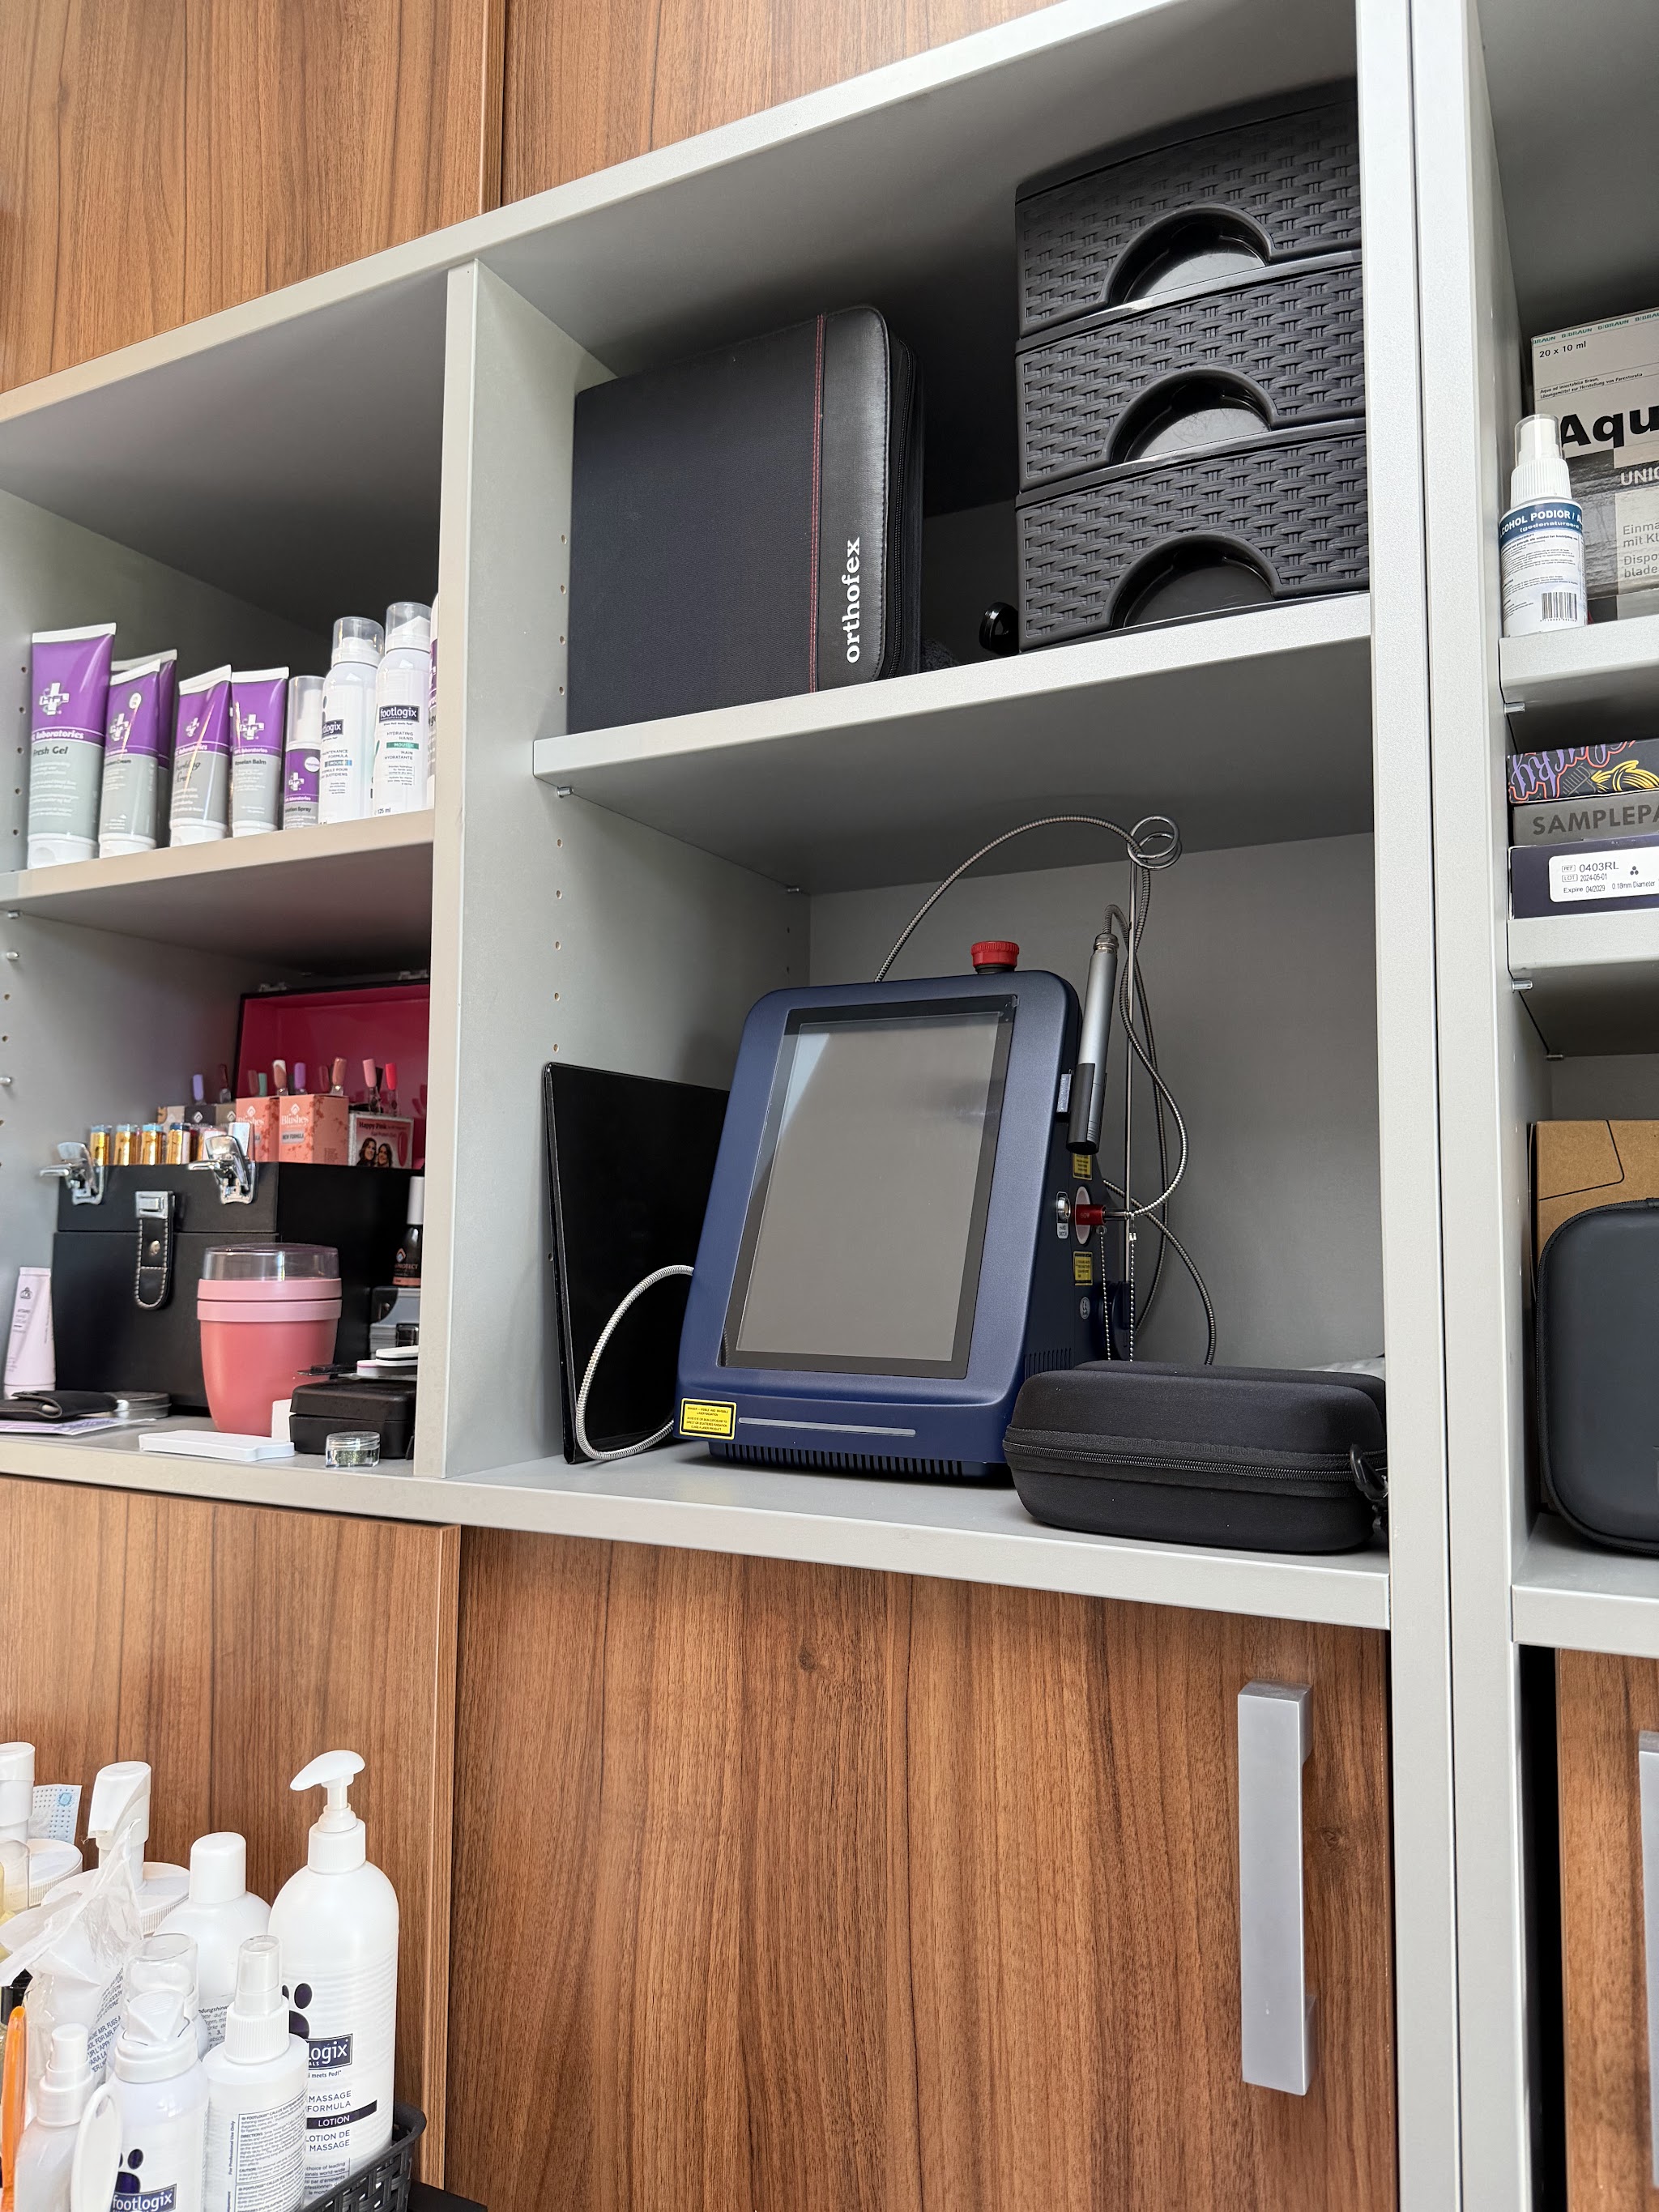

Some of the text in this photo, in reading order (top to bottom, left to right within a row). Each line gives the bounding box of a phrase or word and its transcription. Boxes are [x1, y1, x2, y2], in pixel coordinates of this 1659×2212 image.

[1539, 349, 1550, 358] 20
[1563, 344, 1573, 352] 10
[1576, 340, 1586, 349] ml
[1500, 515, 1528, 538] COHOL
[1530, 509, 1571, 521] PODIOR
[1623, 536, 1643, 548] mit
[841, 536, 860, 663] orthofex
[380, 708, 417, 718] footlogix
[36, 730, 84, 739] laboratories
[52, 745, 69, 754] Gel
[1579, 861, 1619, 872] 0403RL
[1580, 874, 1608, 882] 2024-05-01
[281, 1115, 309, 1124] Blushes
[309, 2040, 348, 2064] ogix
[309, 2090, 352, 2103] MASSAGE
[307, 2100, 351, 2112] FORMULA
[318, 2115, 350, 2127] LOTION
[339, 2129, 350, 2138] DE
[309, 2139, 350, 2151] MASSAGE
[113, 2191, 173, 2212] footlogix
